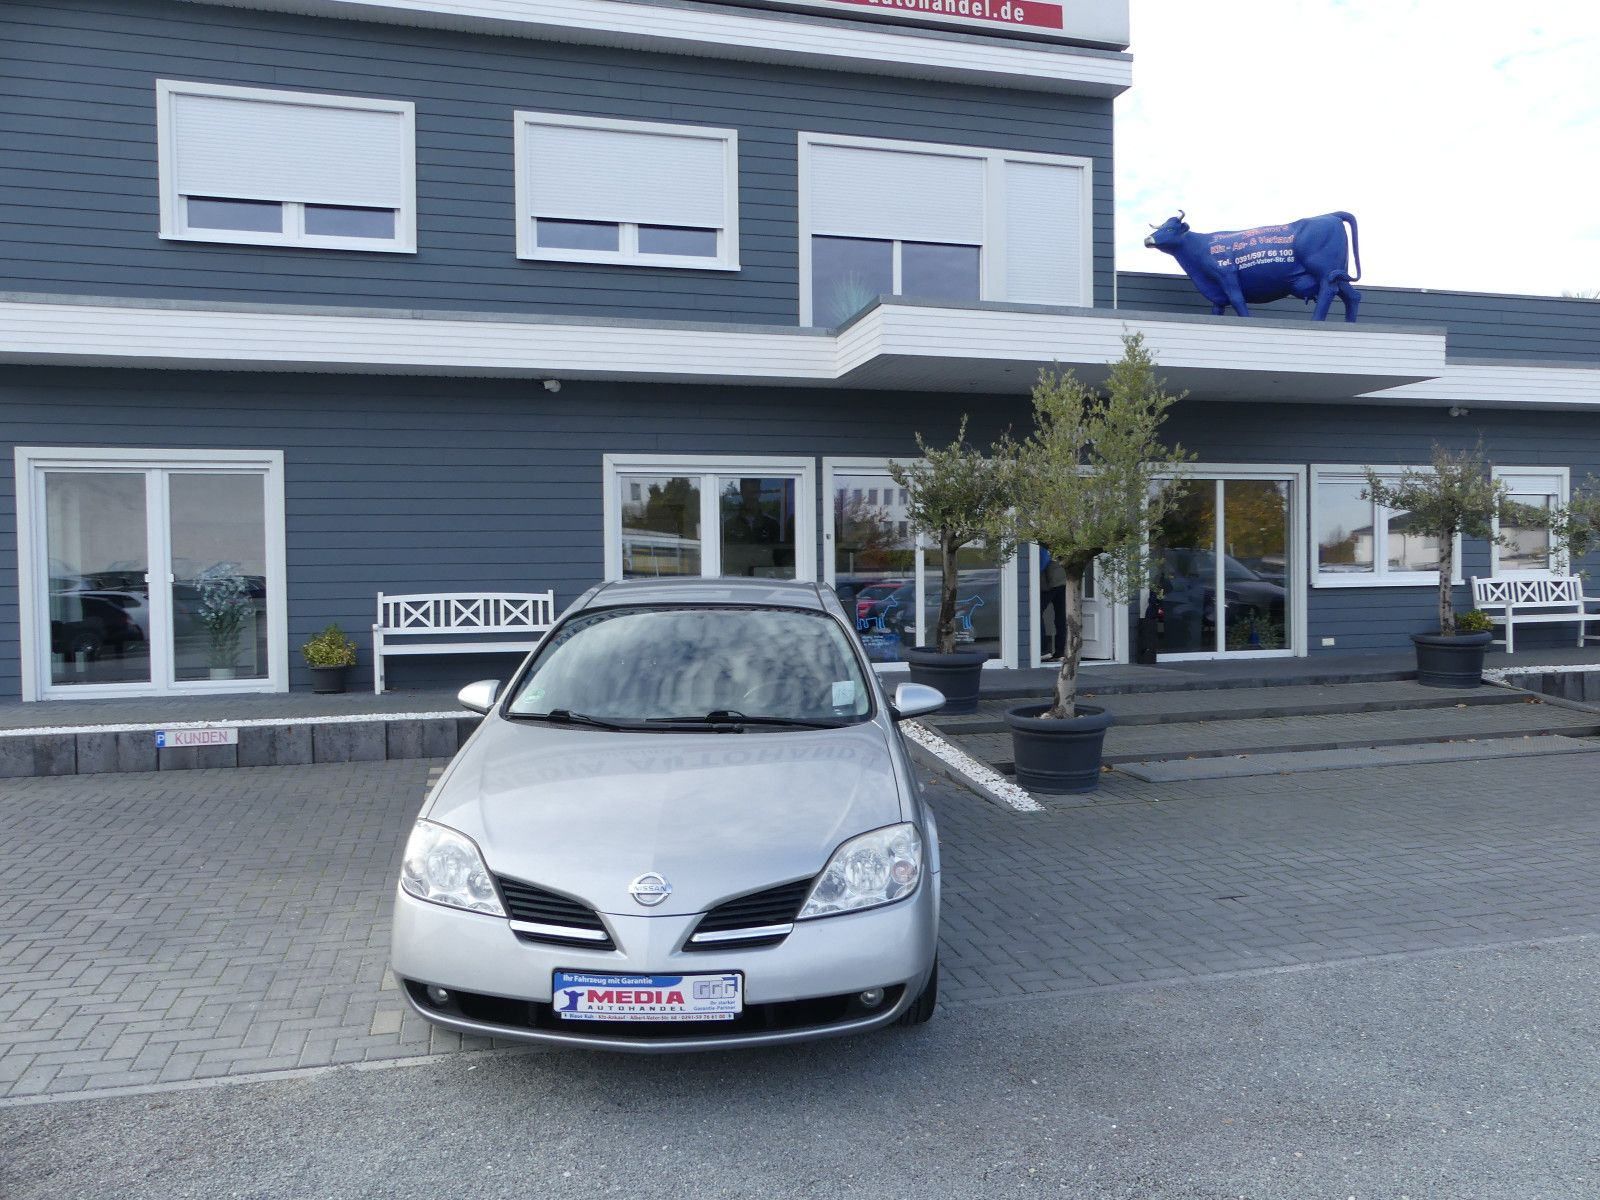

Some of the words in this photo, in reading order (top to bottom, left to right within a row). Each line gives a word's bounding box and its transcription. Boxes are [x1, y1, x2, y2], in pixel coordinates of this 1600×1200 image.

[1259, 235, 1294, 244] Verkauf
[1235, 251, 1266, 264] 0391/597
[157, 734, 165, 744] P
[175, 731, 228, 744] KUNDEN
[563, 974, 573, 982] Ihr
[574, 975, 607, 985] Fahrzeug
[621, 977, 653, 985] Garantie
[587, 989, 685, 1004] MEDIA
